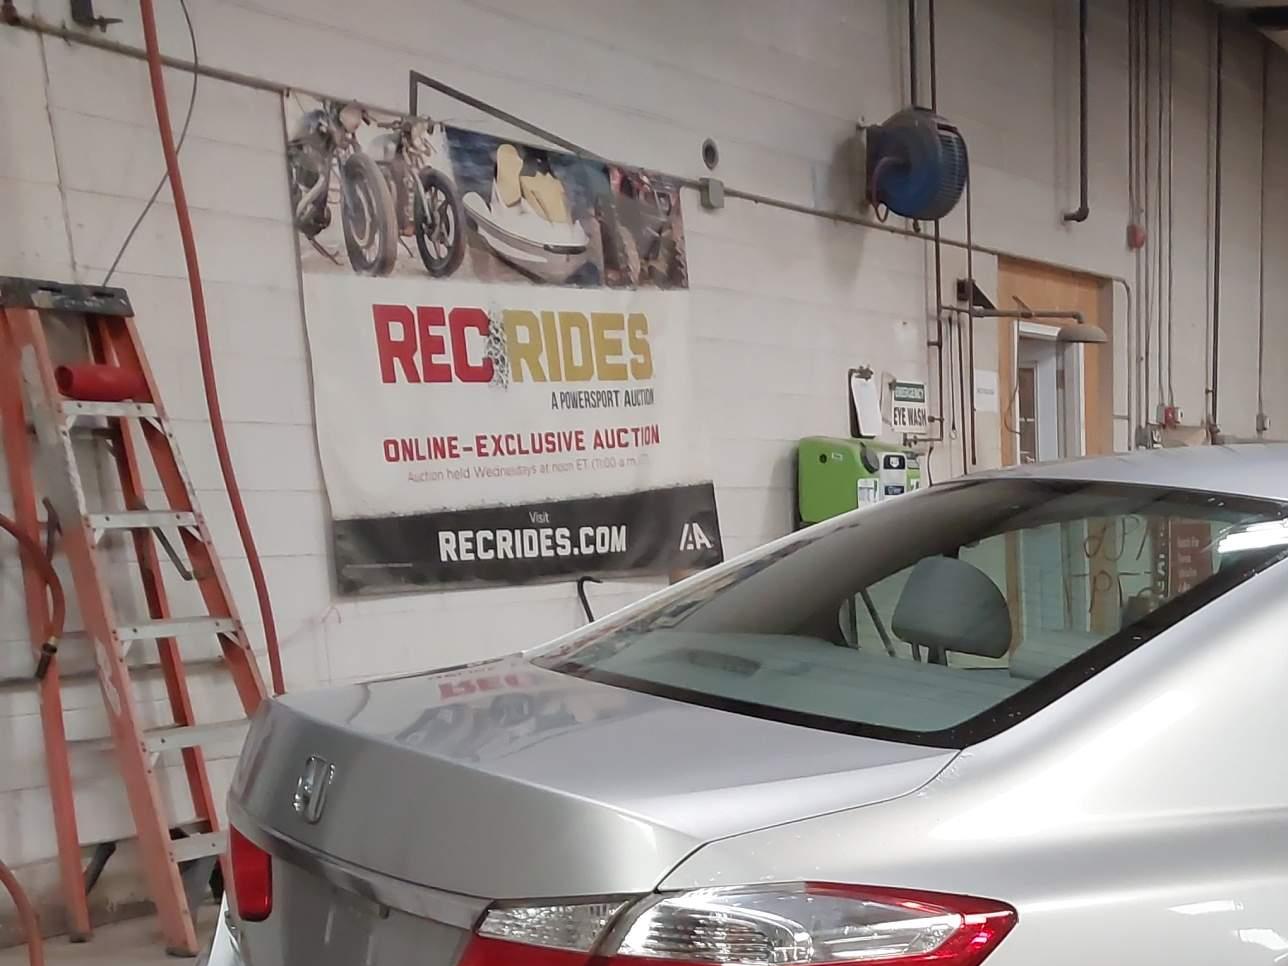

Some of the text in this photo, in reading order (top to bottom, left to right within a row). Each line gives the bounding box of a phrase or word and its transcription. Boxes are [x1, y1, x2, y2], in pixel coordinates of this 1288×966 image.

[372, 303, 654, 383] REC RIDES
[551, 388, 655, 410] A POWERSPORT AUCTION
[893, 407, 928, 427] EYE WASH
[383, 423, 661, 463] ONLINE-EXCLUSIVE AUCTION
[408, 469, 444, 482] Auction
[446, 466, 471, 480] held
[473, 463, 538, 479] Wednesdays
[540, 464, 550, 474] at
[551, 461, 575, 473] noon
[576, 459, 590, 470] ET
[529, 510, 550, 524] Visit
[438, 525, 627, 562] RECRIDES.COM
